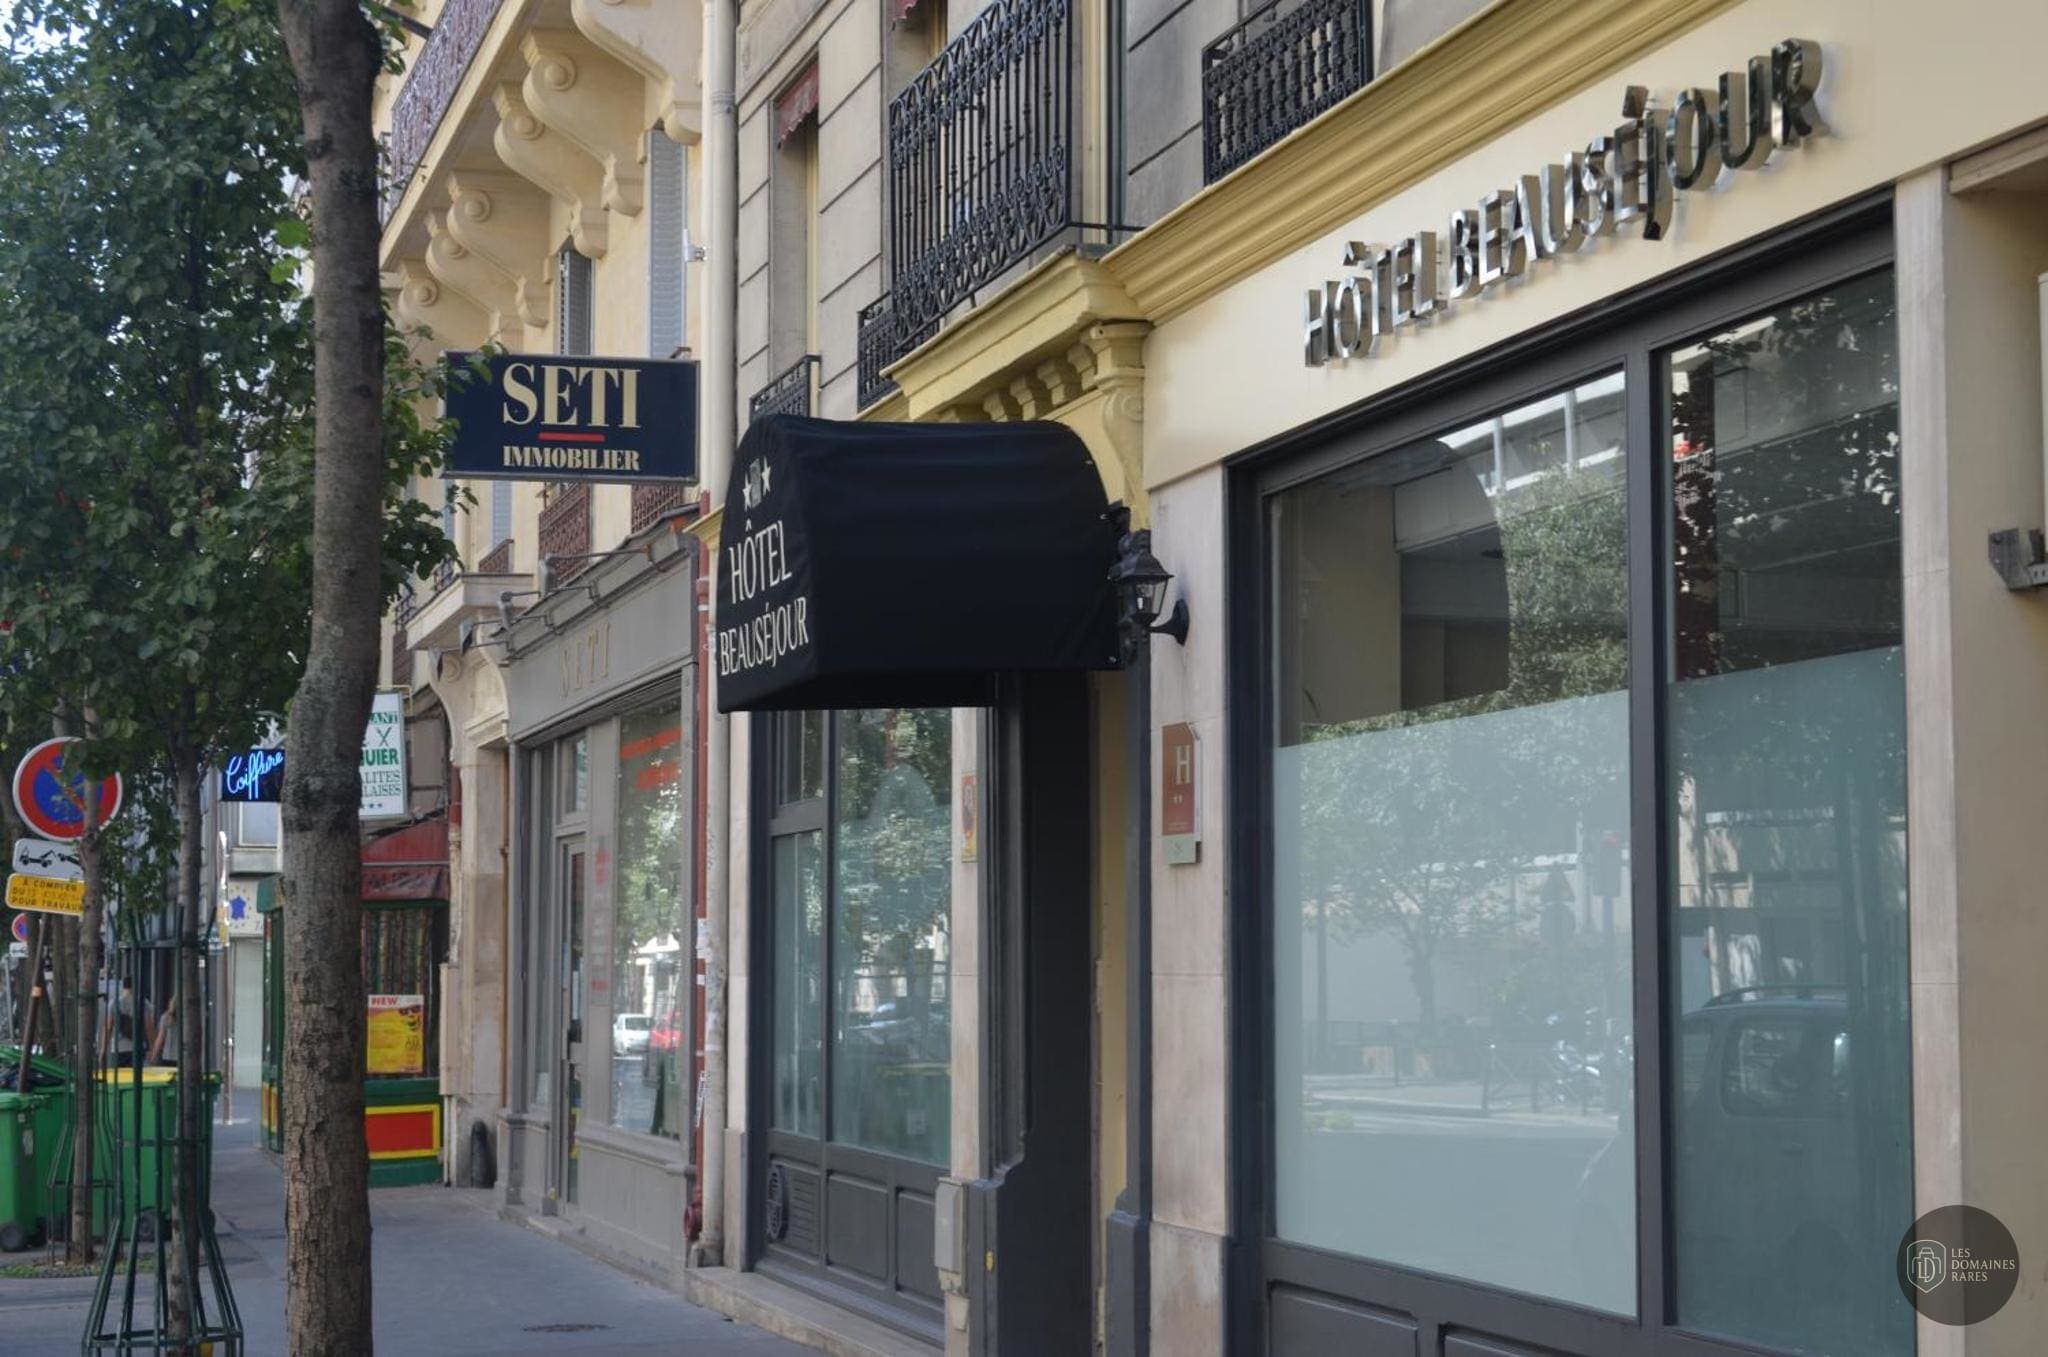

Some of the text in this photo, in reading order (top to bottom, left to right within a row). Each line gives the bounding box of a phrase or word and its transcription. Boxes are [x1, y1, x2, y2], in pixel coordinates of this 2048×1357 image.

[1303, 37, 1824, 368] HÔTEL BEAUSÉJOUR
[502, 362, 642, 429] SETI
[502, 445, 641, 472] IMMOBILIER
[729, 517, 793, 605] HÔTEL
[719, 596, 809, 677] BEAUSÉJOUR
[226, 750, 284, 800] Coiffure
[360, 747, 399, 766] UIER
[1175, 744, 1191, 785] H
